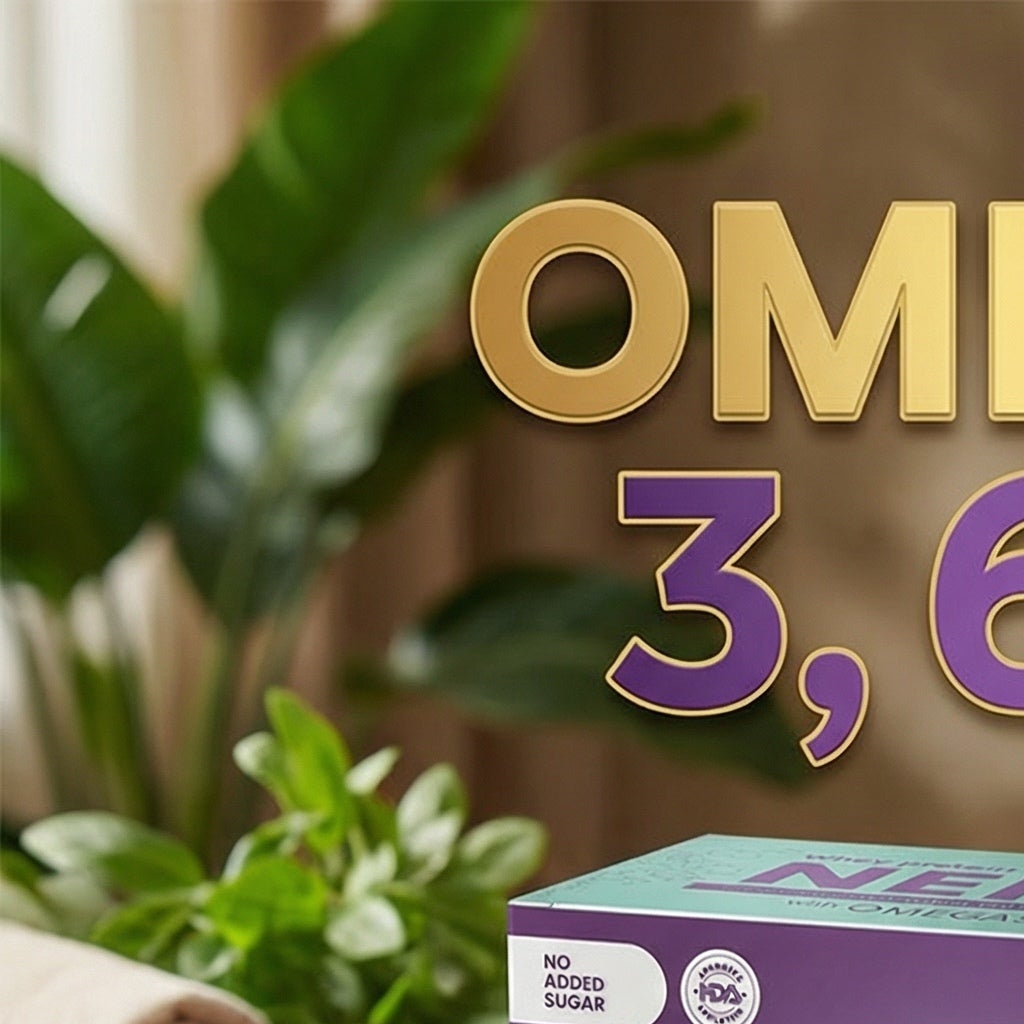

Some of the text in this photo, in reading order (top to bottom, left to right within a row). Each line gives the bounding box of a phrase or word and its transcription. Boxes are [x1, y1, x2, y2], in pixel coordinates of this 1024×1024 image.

[543, 953, 571, 970] NO
[543, 973, 605, 992] ADDED
[543, 992, 606, 1012] SUGAR
